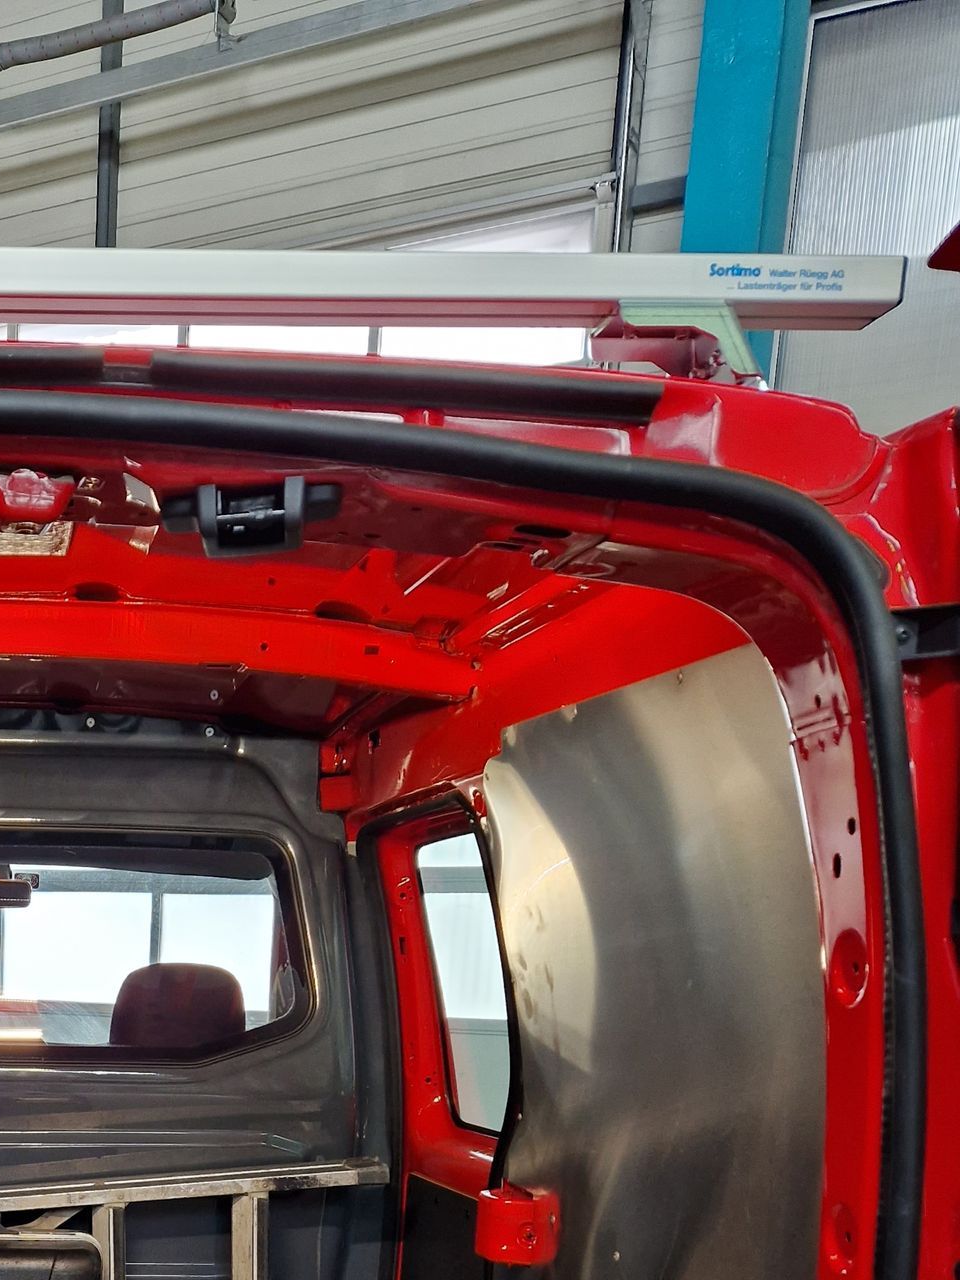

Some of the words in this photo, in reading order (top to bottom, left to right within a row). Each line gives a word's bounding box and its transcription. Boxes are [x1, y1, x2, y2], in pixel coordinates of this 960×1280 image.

[709, 263, 761, 277] Sortimo
[769, 268, 796, 278] Walter
[831, 269, 845, 279] AG
[800, 281, 813, 291] für
[816, 282, 842, 292] Profis
